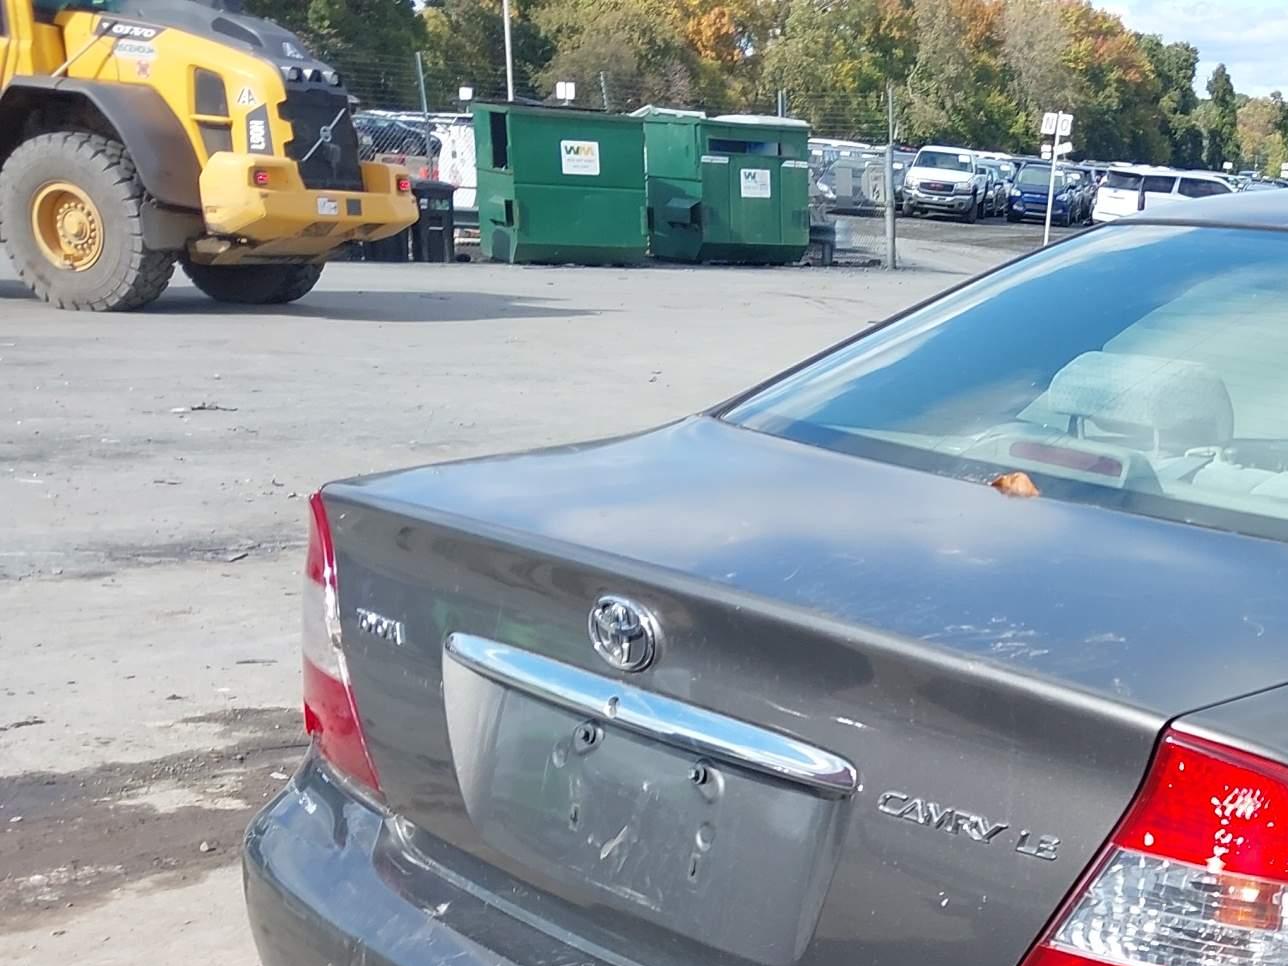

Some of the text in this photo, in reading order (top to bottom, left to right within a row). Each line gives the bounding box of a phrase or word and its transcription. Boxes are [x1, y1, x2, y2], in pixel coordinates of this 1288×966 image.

[564, 144, 595, 156] WM
[877, 790, 1061, 861] CAMRY LE
